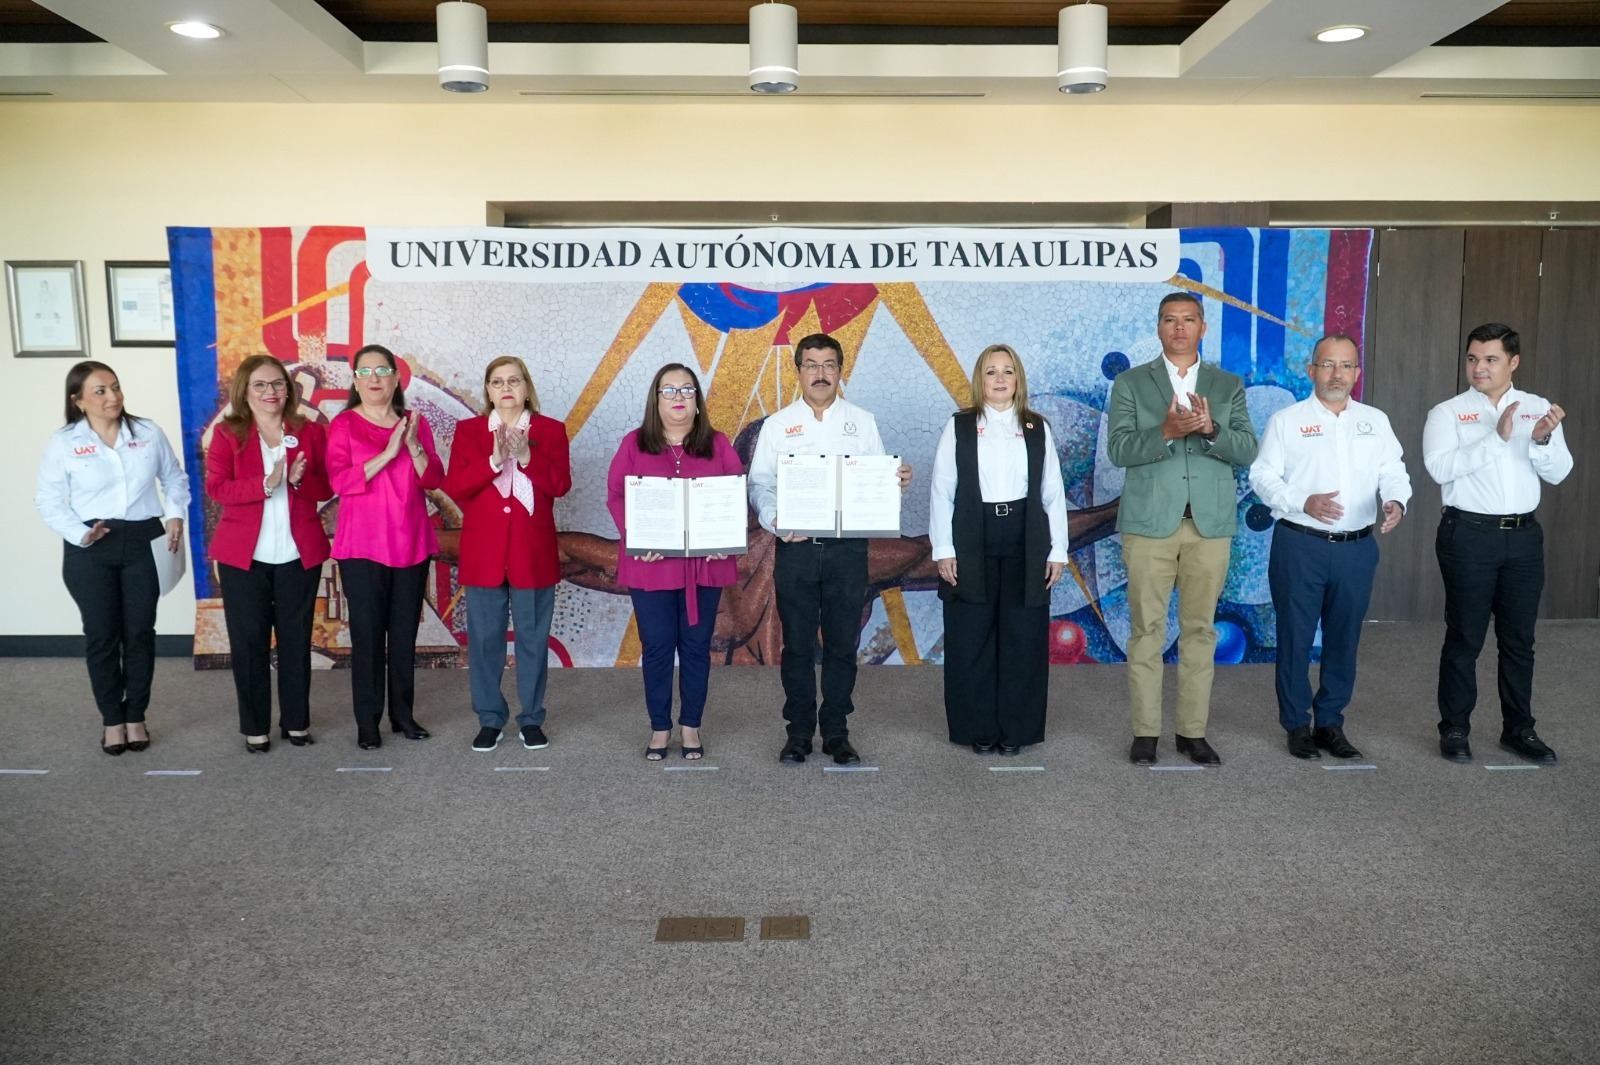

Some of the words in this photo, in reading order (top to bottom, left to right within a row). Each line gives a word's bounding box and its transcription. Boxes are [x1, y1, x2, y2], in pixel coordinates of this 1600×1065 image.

[389, 239, 642, 269] UNIVERSIDAD
[649, 234, 861, 269] AUTÓNOMA
[869, 241, 918, 269] DE
[926, 240, 1158, 269] TAMAULIPAS
[1457, 413, 1480, 421] UAT
[785, 424, 803, 434] UAT
[1299, 424, 1322, 434] UAT
[73, 445, 97, 455] UAT
